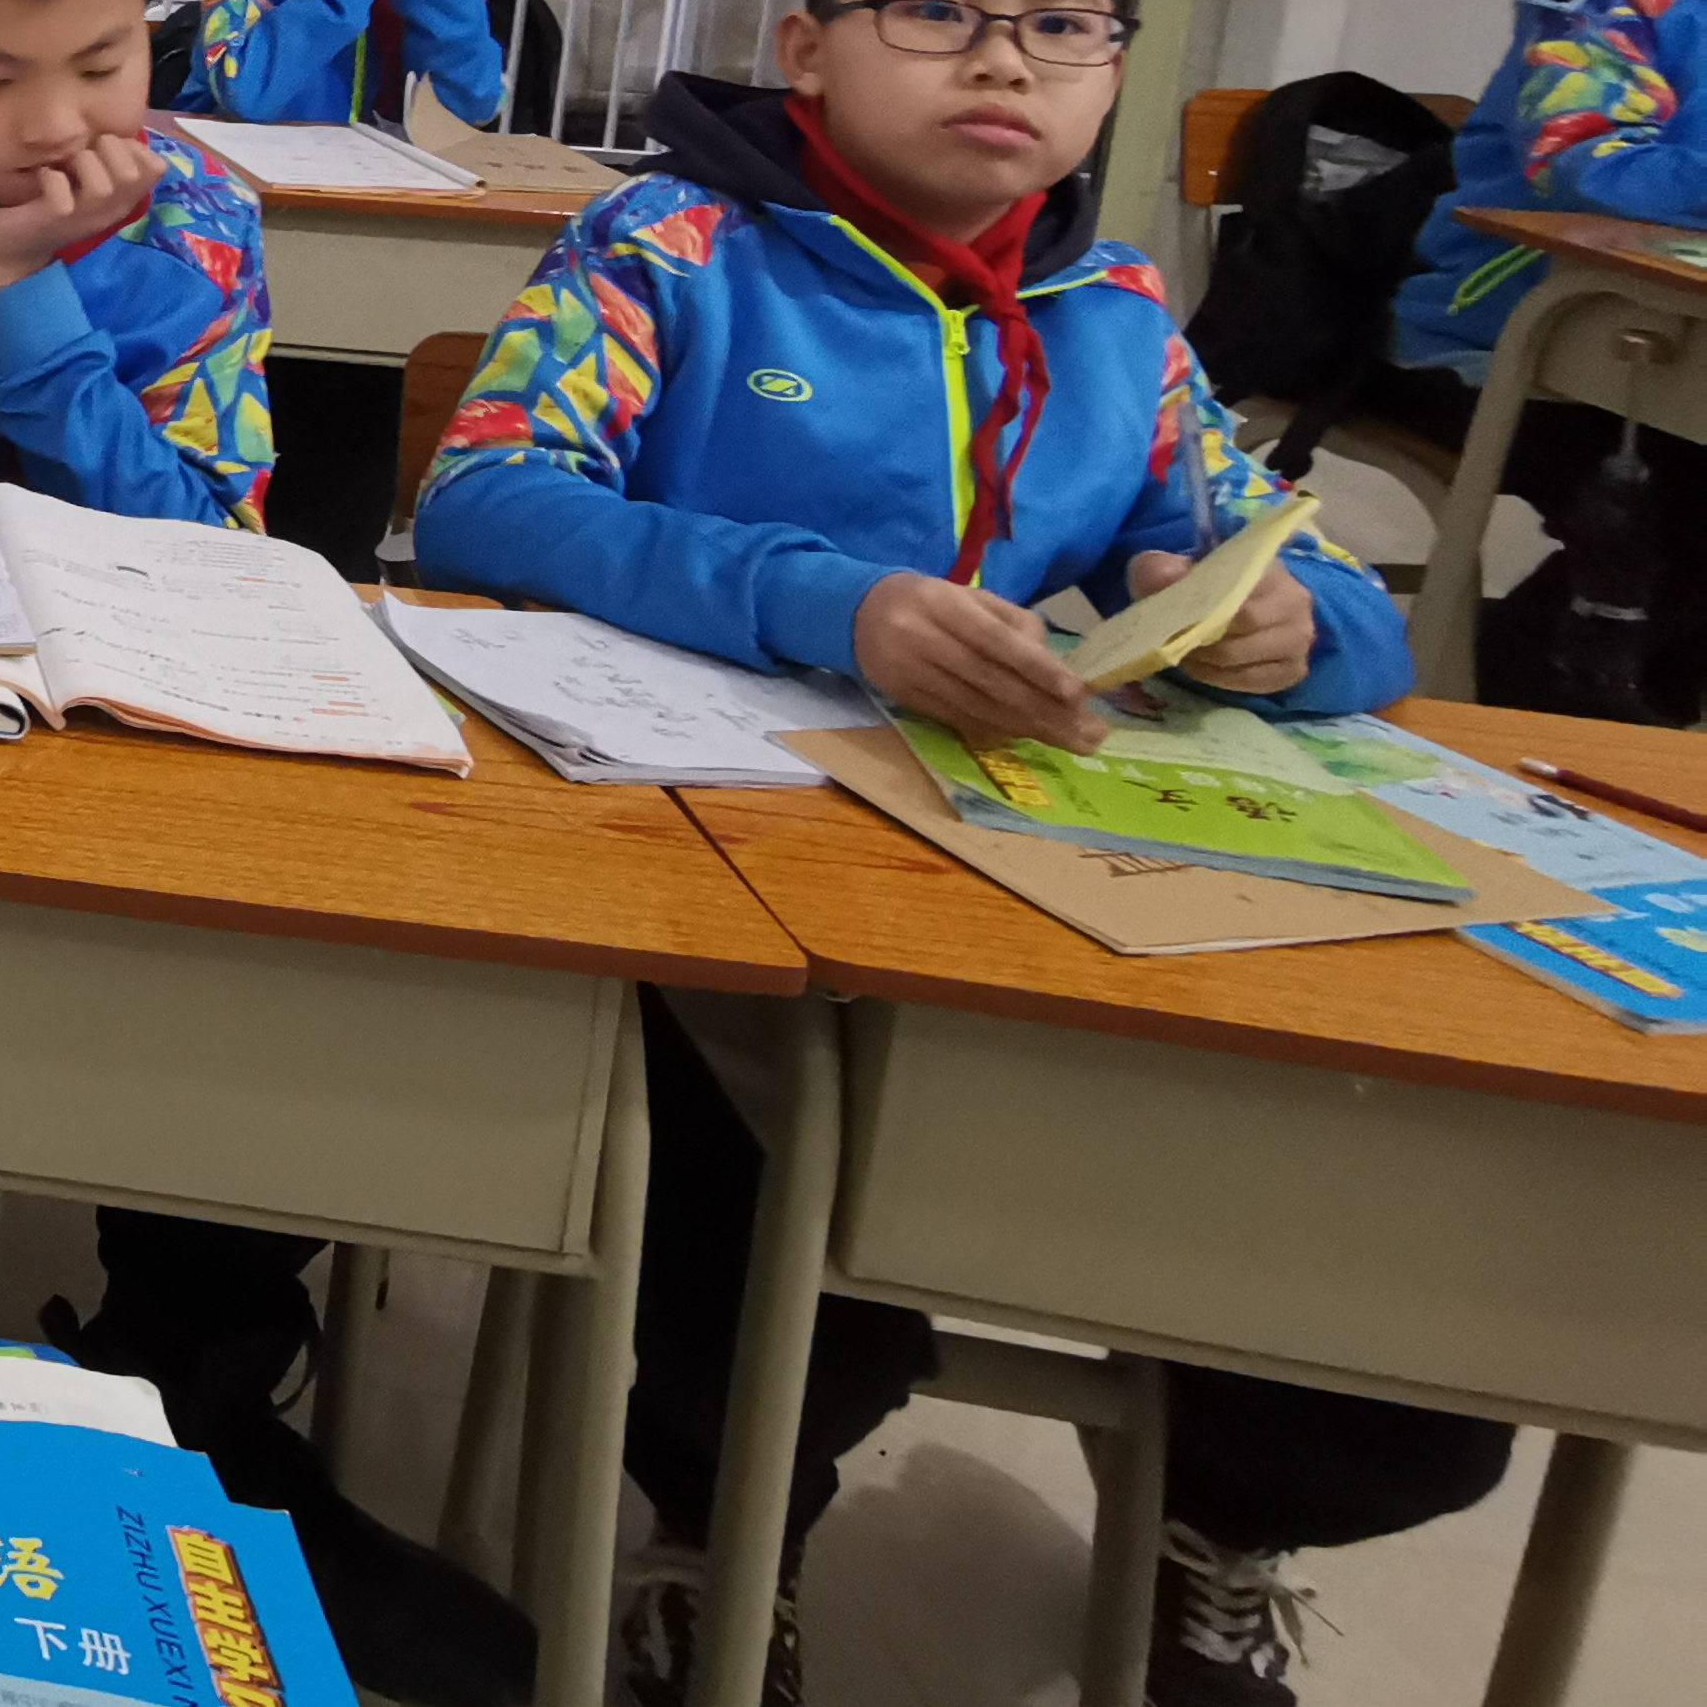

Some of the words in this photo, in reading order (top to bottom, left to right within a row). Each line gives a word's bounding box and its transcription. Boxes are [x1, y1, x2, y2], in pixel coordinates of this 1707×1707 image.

[13, 1615, 132, 1676] 下册
[115, 1504, 164, 1593] ZIZHU
[142, 1594, 195, 1692] XUEXI
